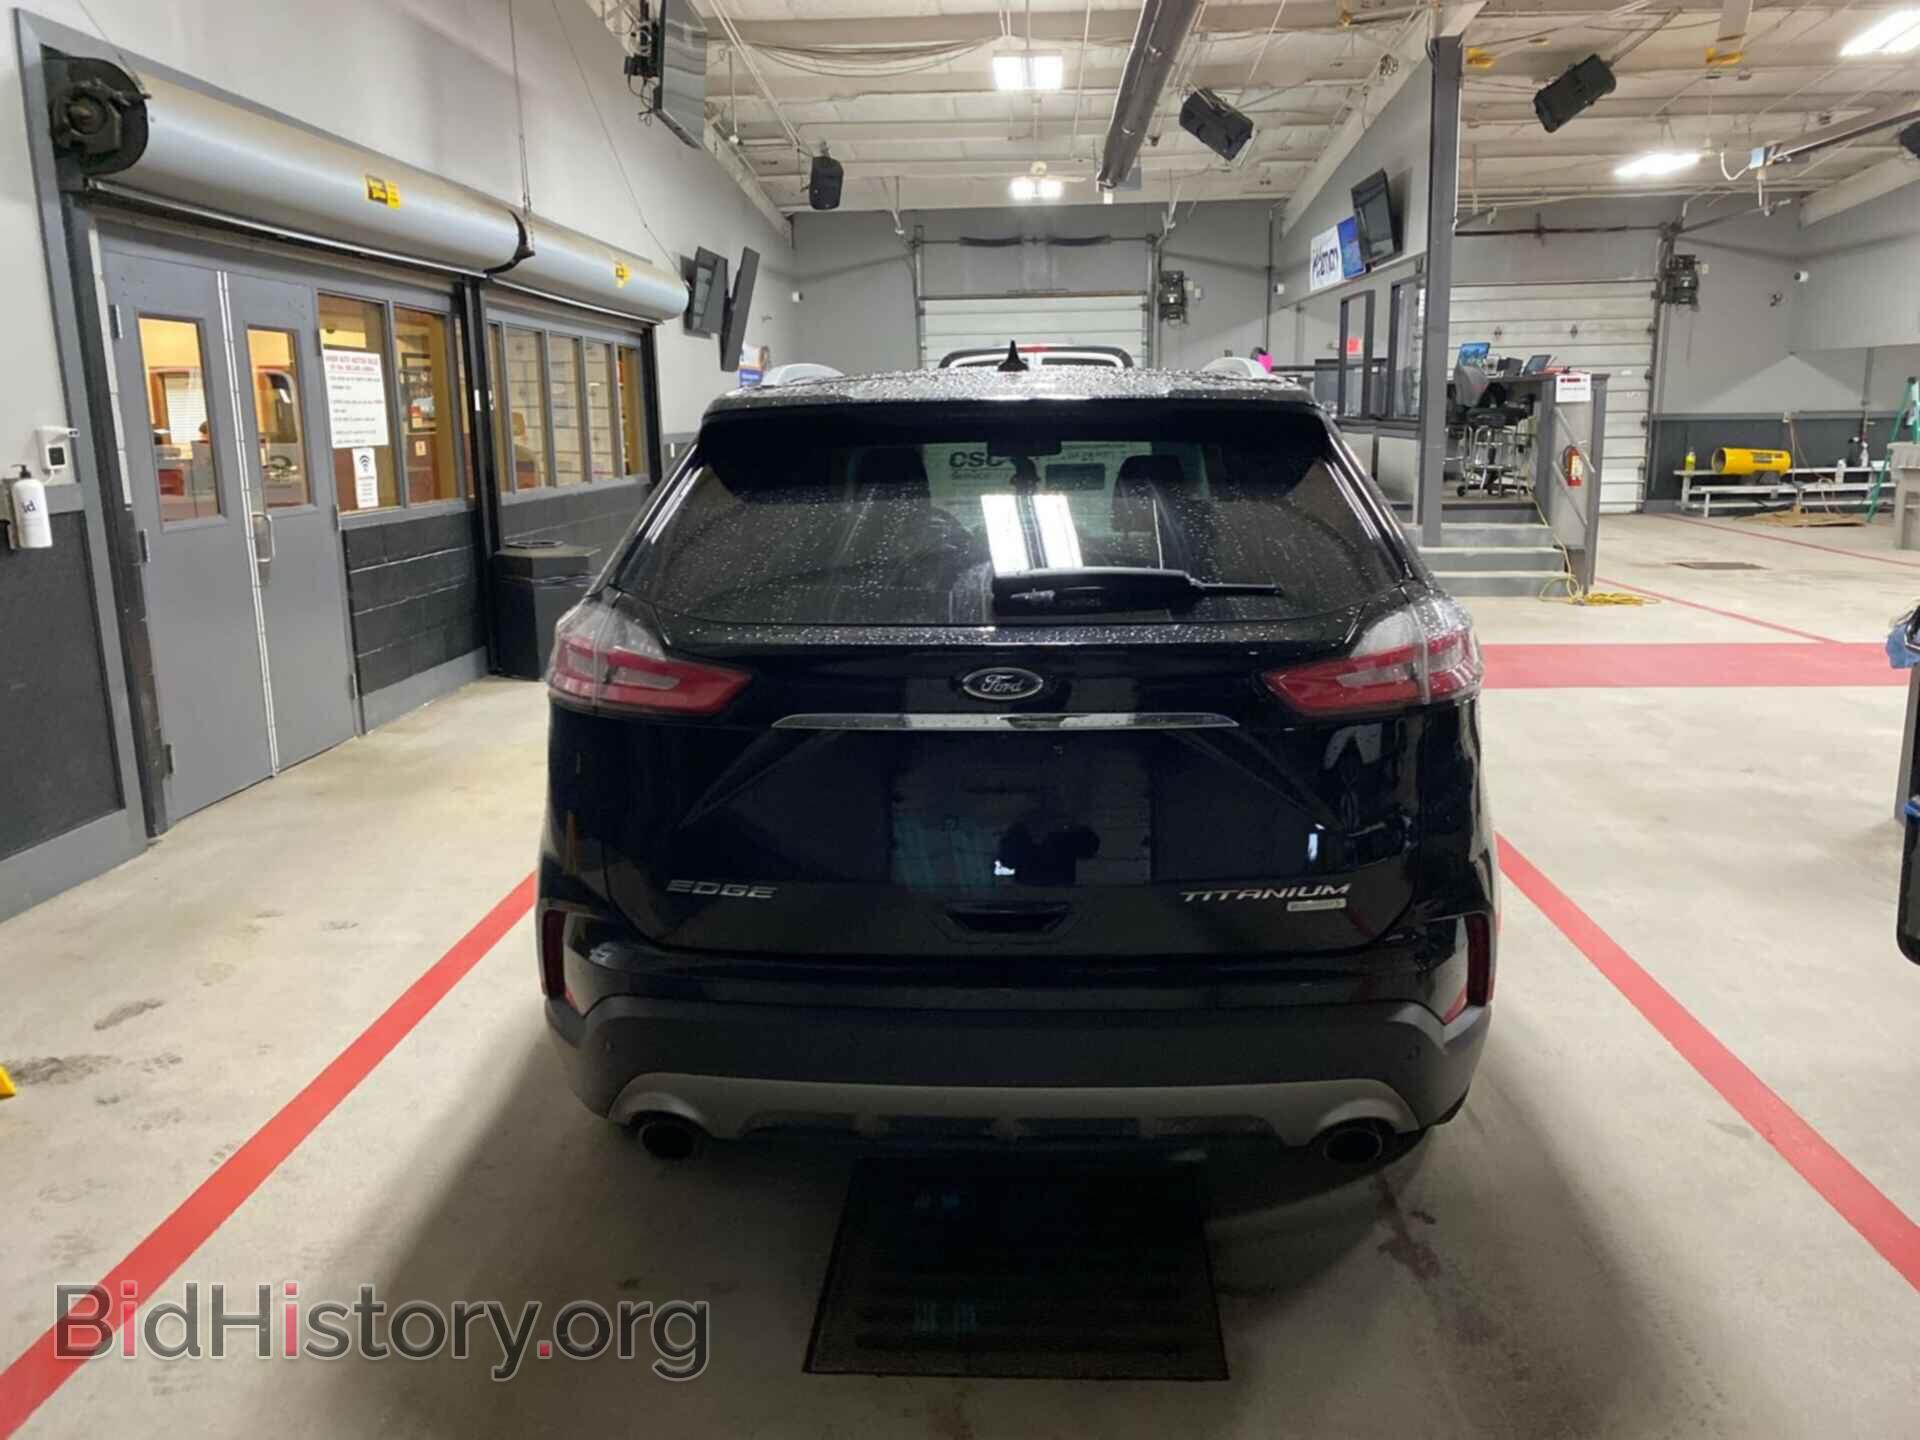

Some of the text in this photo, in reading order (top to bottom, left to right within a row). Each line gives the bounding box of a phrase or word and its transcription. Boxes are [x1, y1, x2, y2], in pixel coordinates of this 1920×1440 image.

[981, 674, 1024, 692] Ford
[665, 880, 779, 899] EDGE
[1180, 883, 1351, 902] TITANIUM
